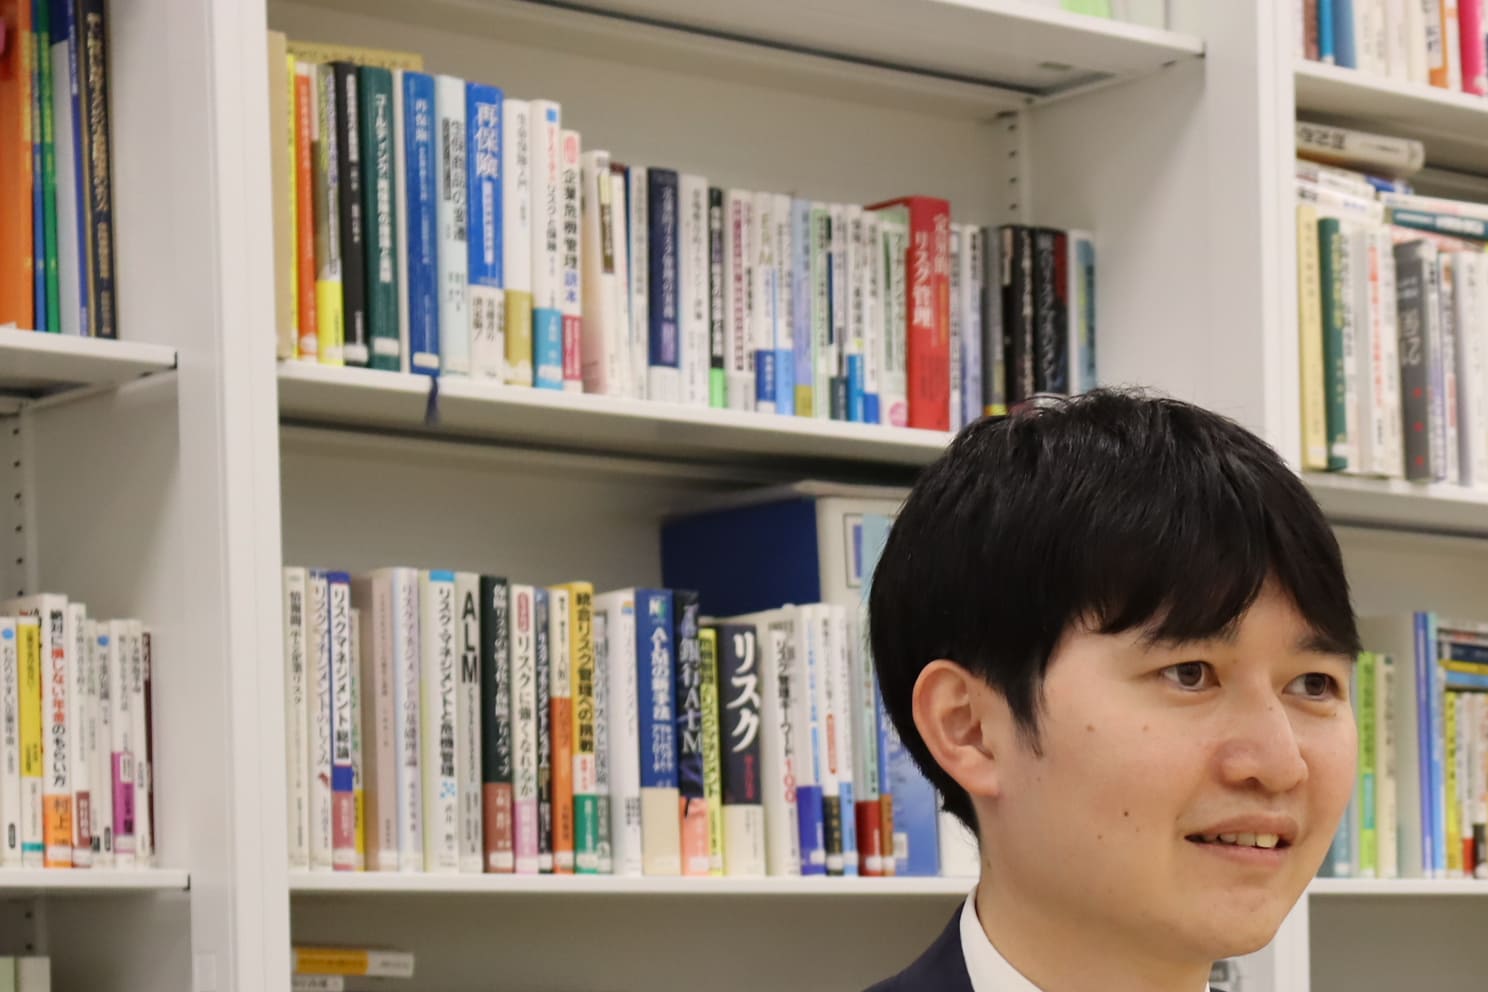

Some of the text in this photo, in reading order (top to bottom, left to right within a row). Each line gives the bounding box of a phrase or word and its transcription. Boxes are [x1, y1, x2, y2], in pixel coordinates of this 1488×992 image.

[475, 102, 499, 178] 再保険
[912, 231, 932, 328] リスク管理
[50, 610, 66, 787] 絶対に損しない年金のもらい方
[334, 589, 350, 760] リスクマネジメント総論
[461, 591, 478, 684] ALM
[518, 636, 533, 798] リスクに強くなれるか
[576, 591, 594, 754] 統合リスク管理への挑戦
[726, 631, 760, 753] リスク
[776, 640, 797, 803] リスク管理キーワード100
